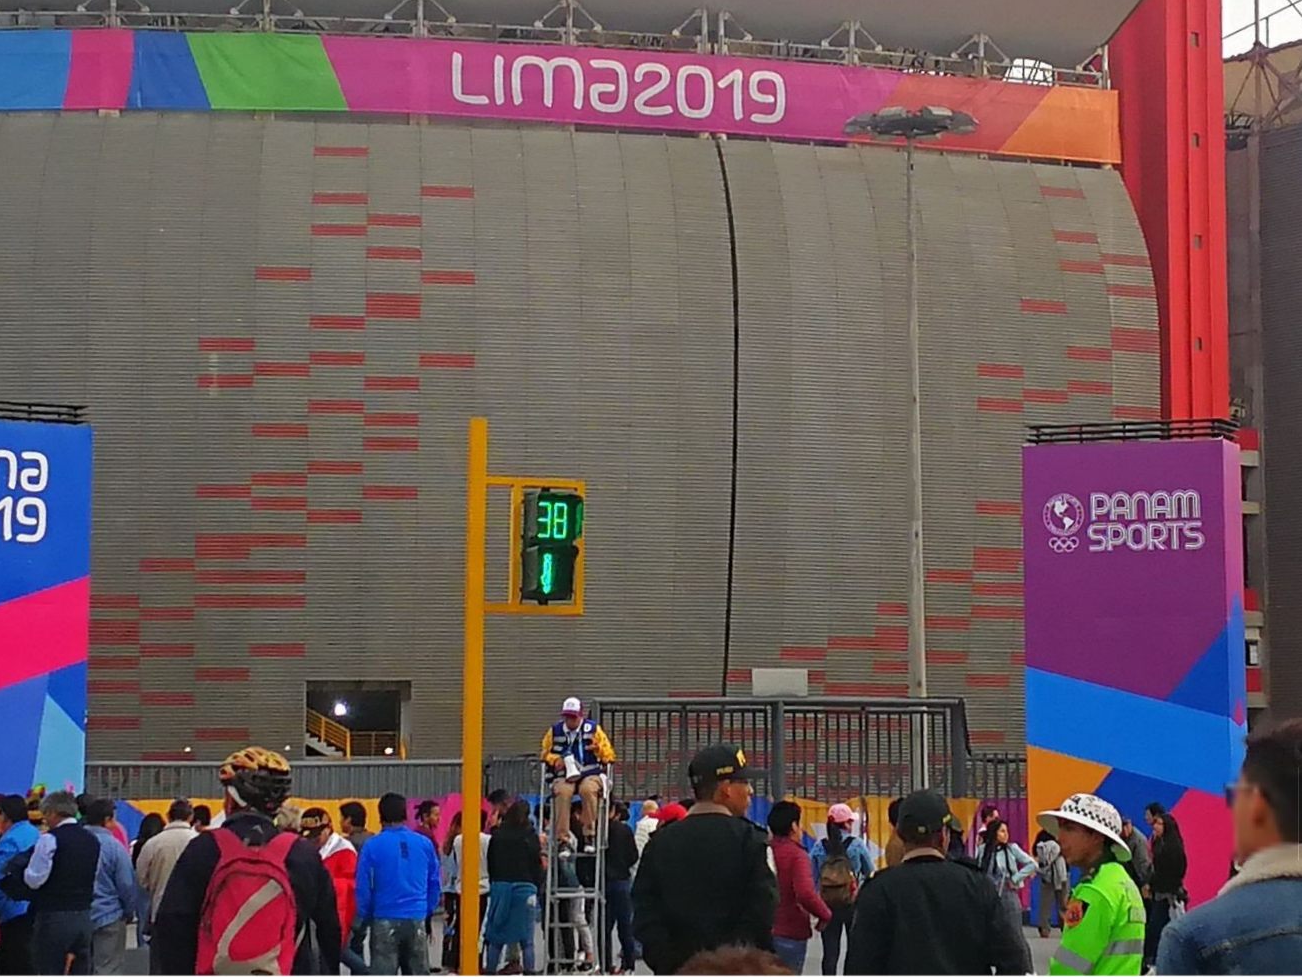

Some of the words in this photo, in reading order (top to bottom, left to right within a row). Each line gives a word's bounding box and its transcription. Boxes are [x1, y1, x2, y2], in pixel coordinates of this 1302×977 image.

[537, 502, 568, 539] 38
[1090, 488, 1202, 522] PANAM
[1087, 521, 1206, 553] SPORTS
